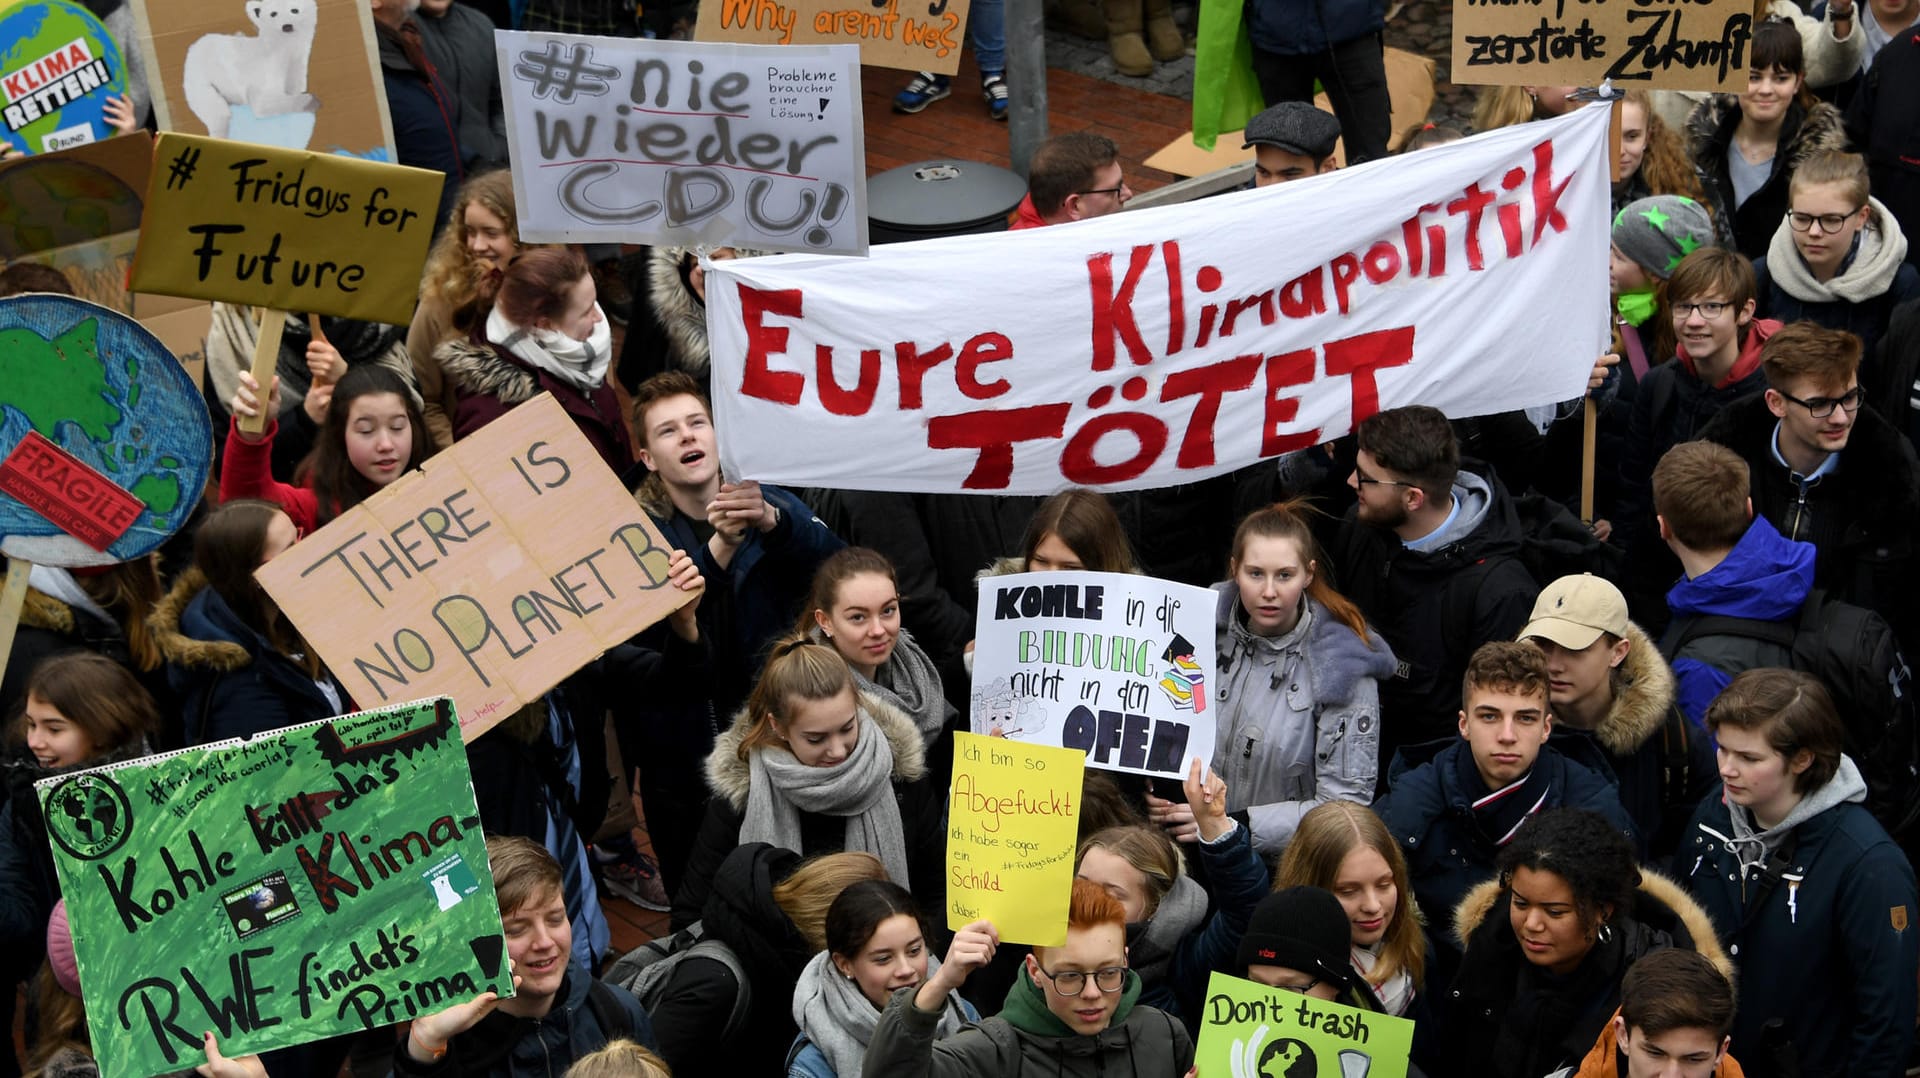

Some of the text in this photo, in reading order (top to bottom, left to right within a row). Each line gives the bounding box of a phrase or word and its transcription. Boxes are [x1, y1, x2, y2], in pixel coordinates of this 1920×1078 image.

[721, 0, 796, 45] Why
[1603, 9, 1752, 84] Zukunft
[3, 58, 112, 132] RETTEN!
[5, 43, 88, 100] KLIMA
[768, 66, 837, 83] Probleme
[769, 83, 833, 94] brauchen
[769, 96, 798, 106] eine
[535, 104, 838, 175] wieder
[229, 158, 351, 218] Fridays
[364, 187, 417, 233] for
[557, 162, 850, 248] CDU!
[188, 223, 365, 292] Future
[738, 139, 1576, 417] Eure Klimapolitik
[927, 325, 1415, 490] TÖTET
[12, 442, 134, 530] FRAGILE
[300, 441, 571, 608] THERE IS
[354, 522, 672, 700] NO PLANET B
[994, 584, 1182, 635] KOHLE in die
[1010, 667, 1150, 714] nicht in den
[963, 741, 1046, 771] Ich bin so
[1062, 704, 1190, 774] OFEN
[954, 773, 1073, 833] Abgefuckt
[97, 830, 236, 933] Kohle
[333, 758, 400, 811] das
[954, 849, 971, 862] ein
[970, 829, 999, 847] habe
[1005, 838, 1040, 858] sogar
[951, 866, 1004, 892] Schild
[951, 900, 980, 919] dabei
[118, 946, 282, 1064] RWE
[1209, 994, 1369, 1044] Don't trash
